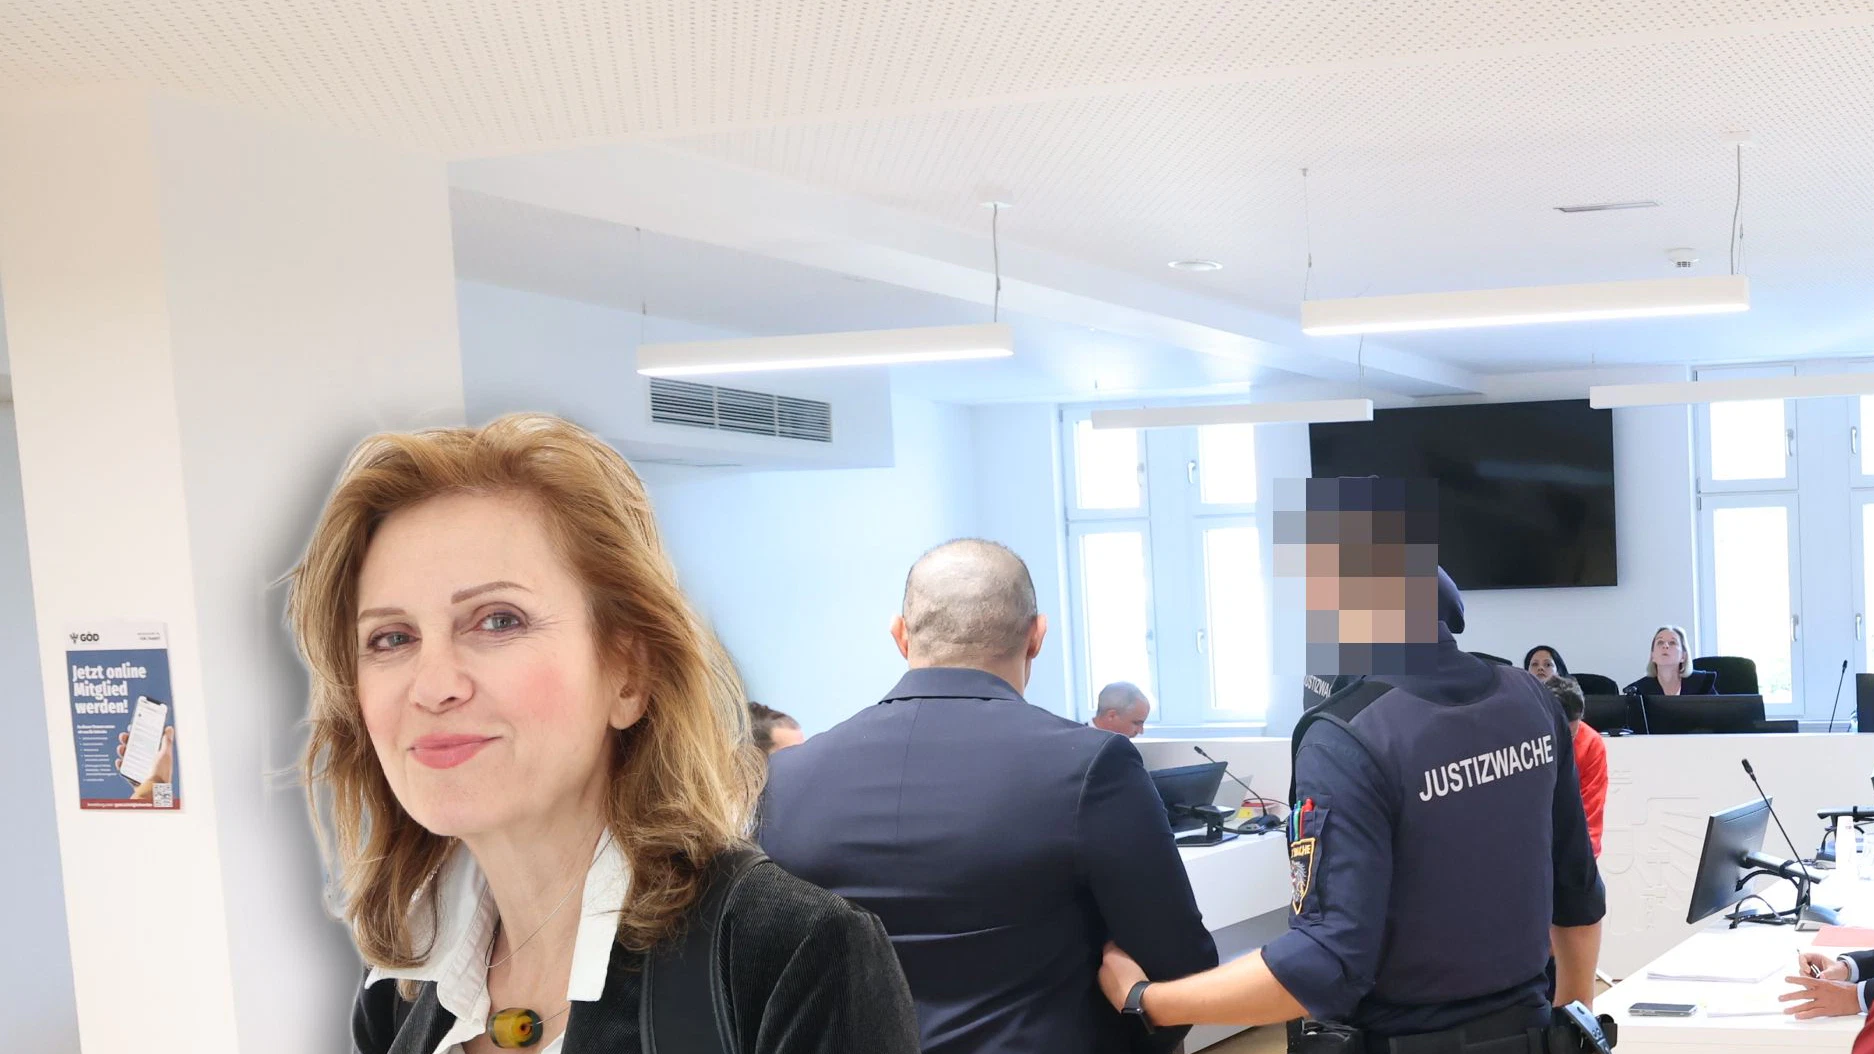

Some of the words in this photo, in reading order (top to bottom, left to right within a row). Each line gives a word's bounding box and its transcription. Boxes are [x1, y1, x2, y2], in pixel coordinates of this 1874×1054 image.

[72, 665, 104, 682] Jetzt
[106, 661, 147, 678] online
[74, 680, 128, 700] Mitglied
[75, 699, 128, 714] werden!
[1419, 735, 1553, 802] JUSTIZWACHE
